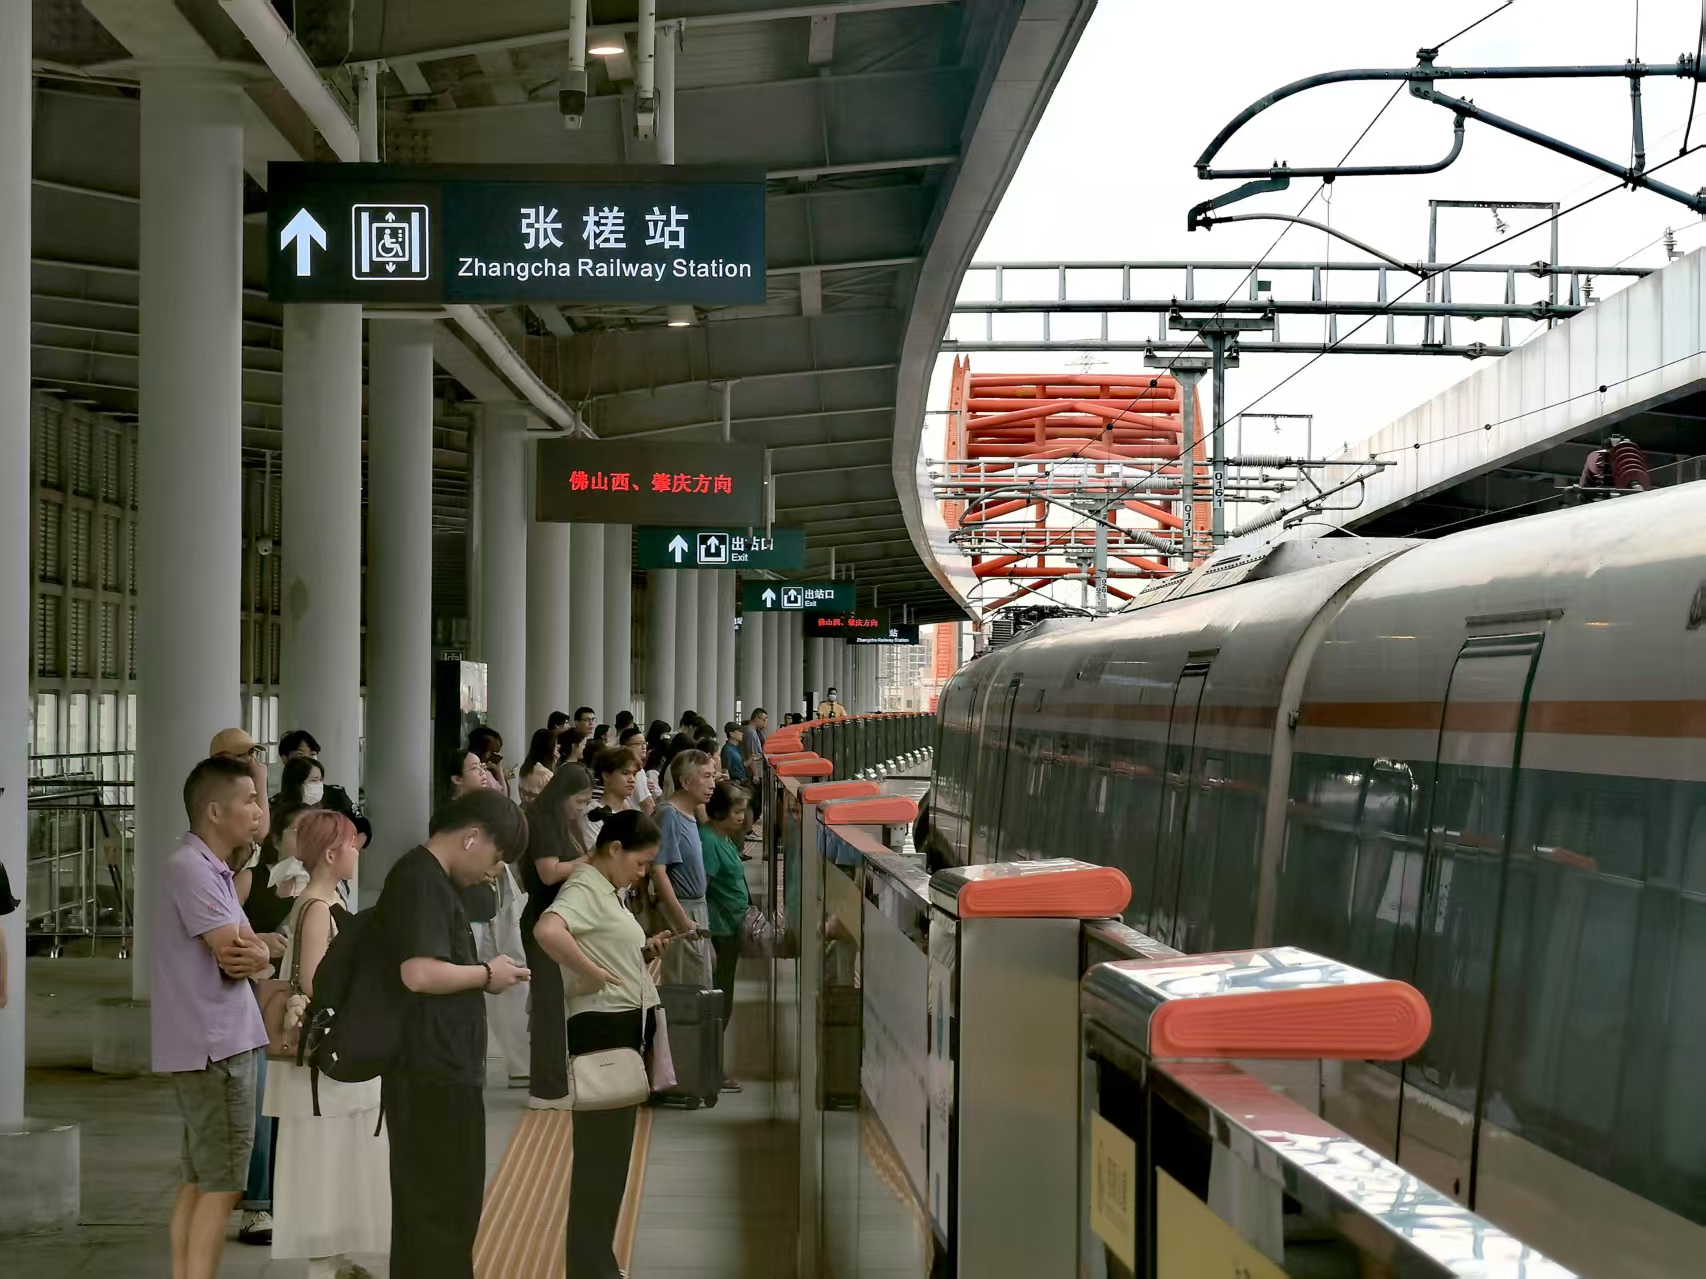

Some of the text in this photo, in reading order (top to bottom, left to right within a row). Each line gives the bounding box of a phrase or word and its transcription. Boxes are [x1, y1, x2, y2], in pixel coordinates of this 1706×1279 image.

[519, 205, 690, 250] 张槎站
[457, 257, 753, 281] Zhangcha Railway Station
[569, 470, 734, 494] 佛山西、肇庆方向
[731, 552, 749, 563] Exit
[804, 589, 834, 600] 出站口
